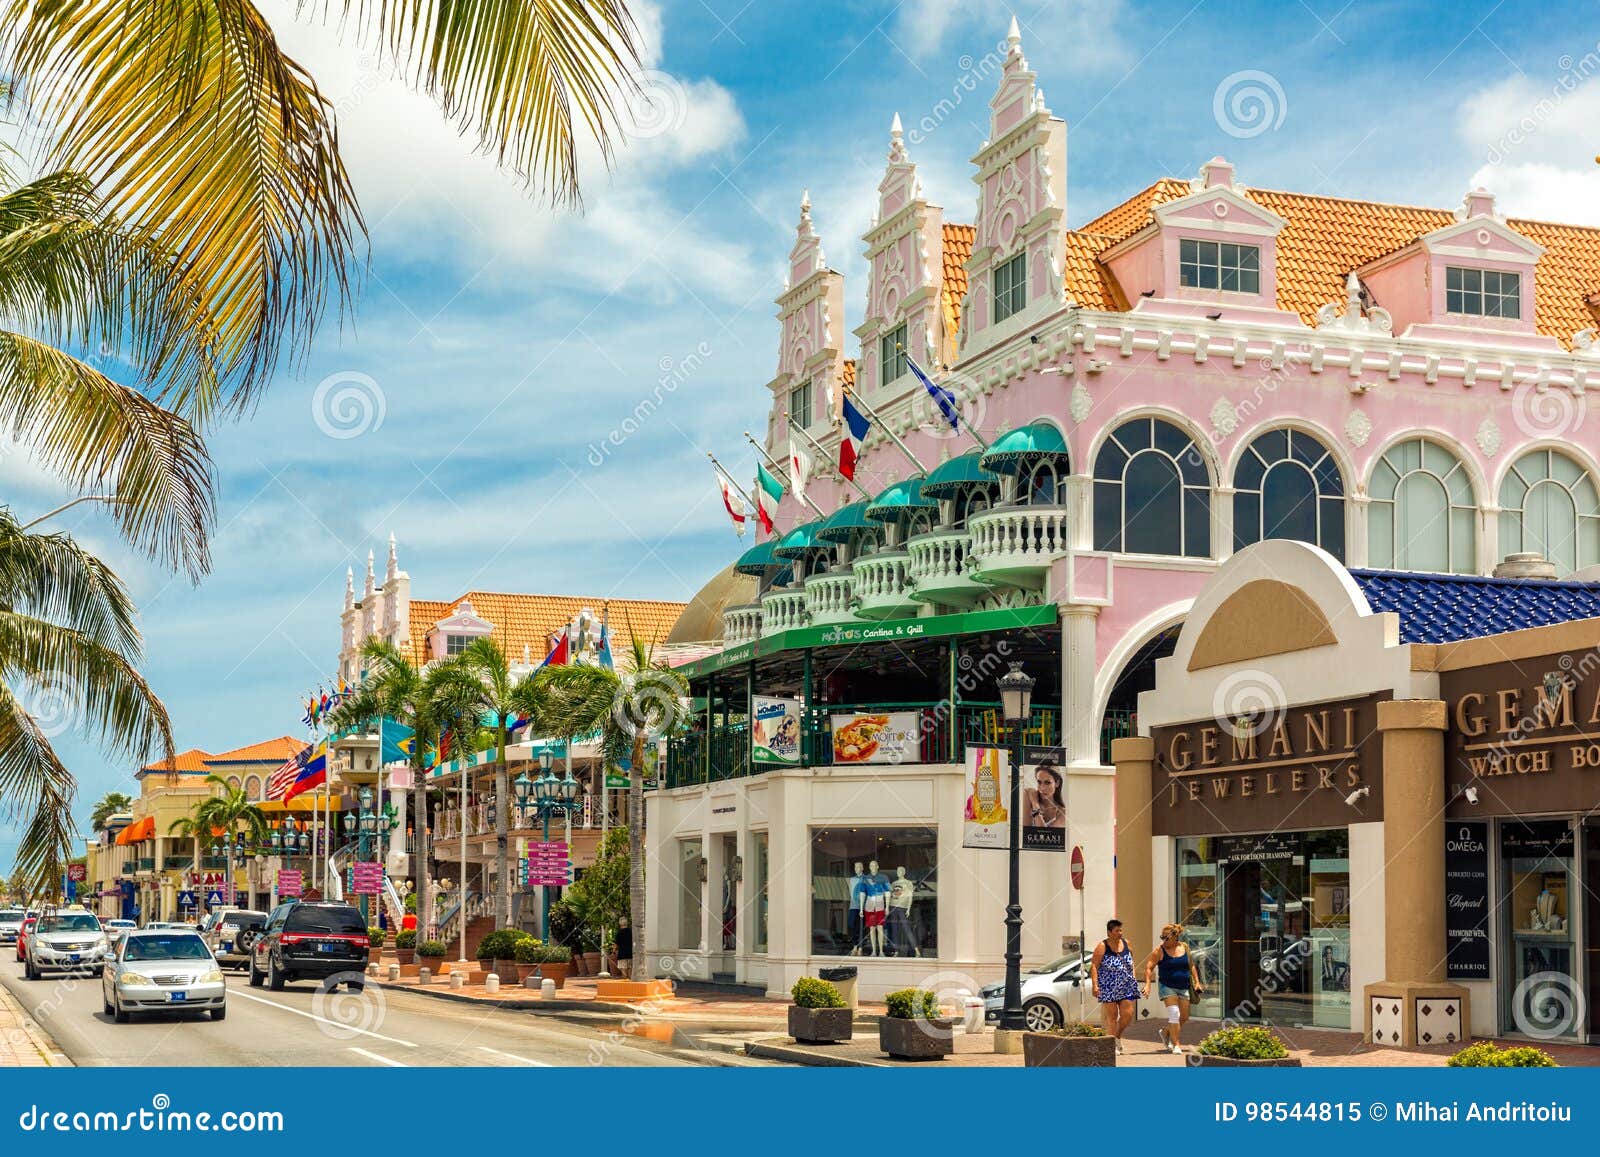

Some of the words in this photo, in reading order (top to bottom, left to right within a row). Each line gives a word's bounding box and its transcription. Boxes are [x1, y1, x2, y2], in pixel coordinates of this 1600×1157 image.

[863, 629, 893, 638] Cantina
[896, 627, 903, 635] &
[907, 625, 923, 636] Grill
[1170, 708, 1357, 770] GEMANI
[1469, 751, 1550, 777] WATCH
[1169, 764, 1361, 807] JEWELERS
[1447, 841, 1484, 852] OMEGA
